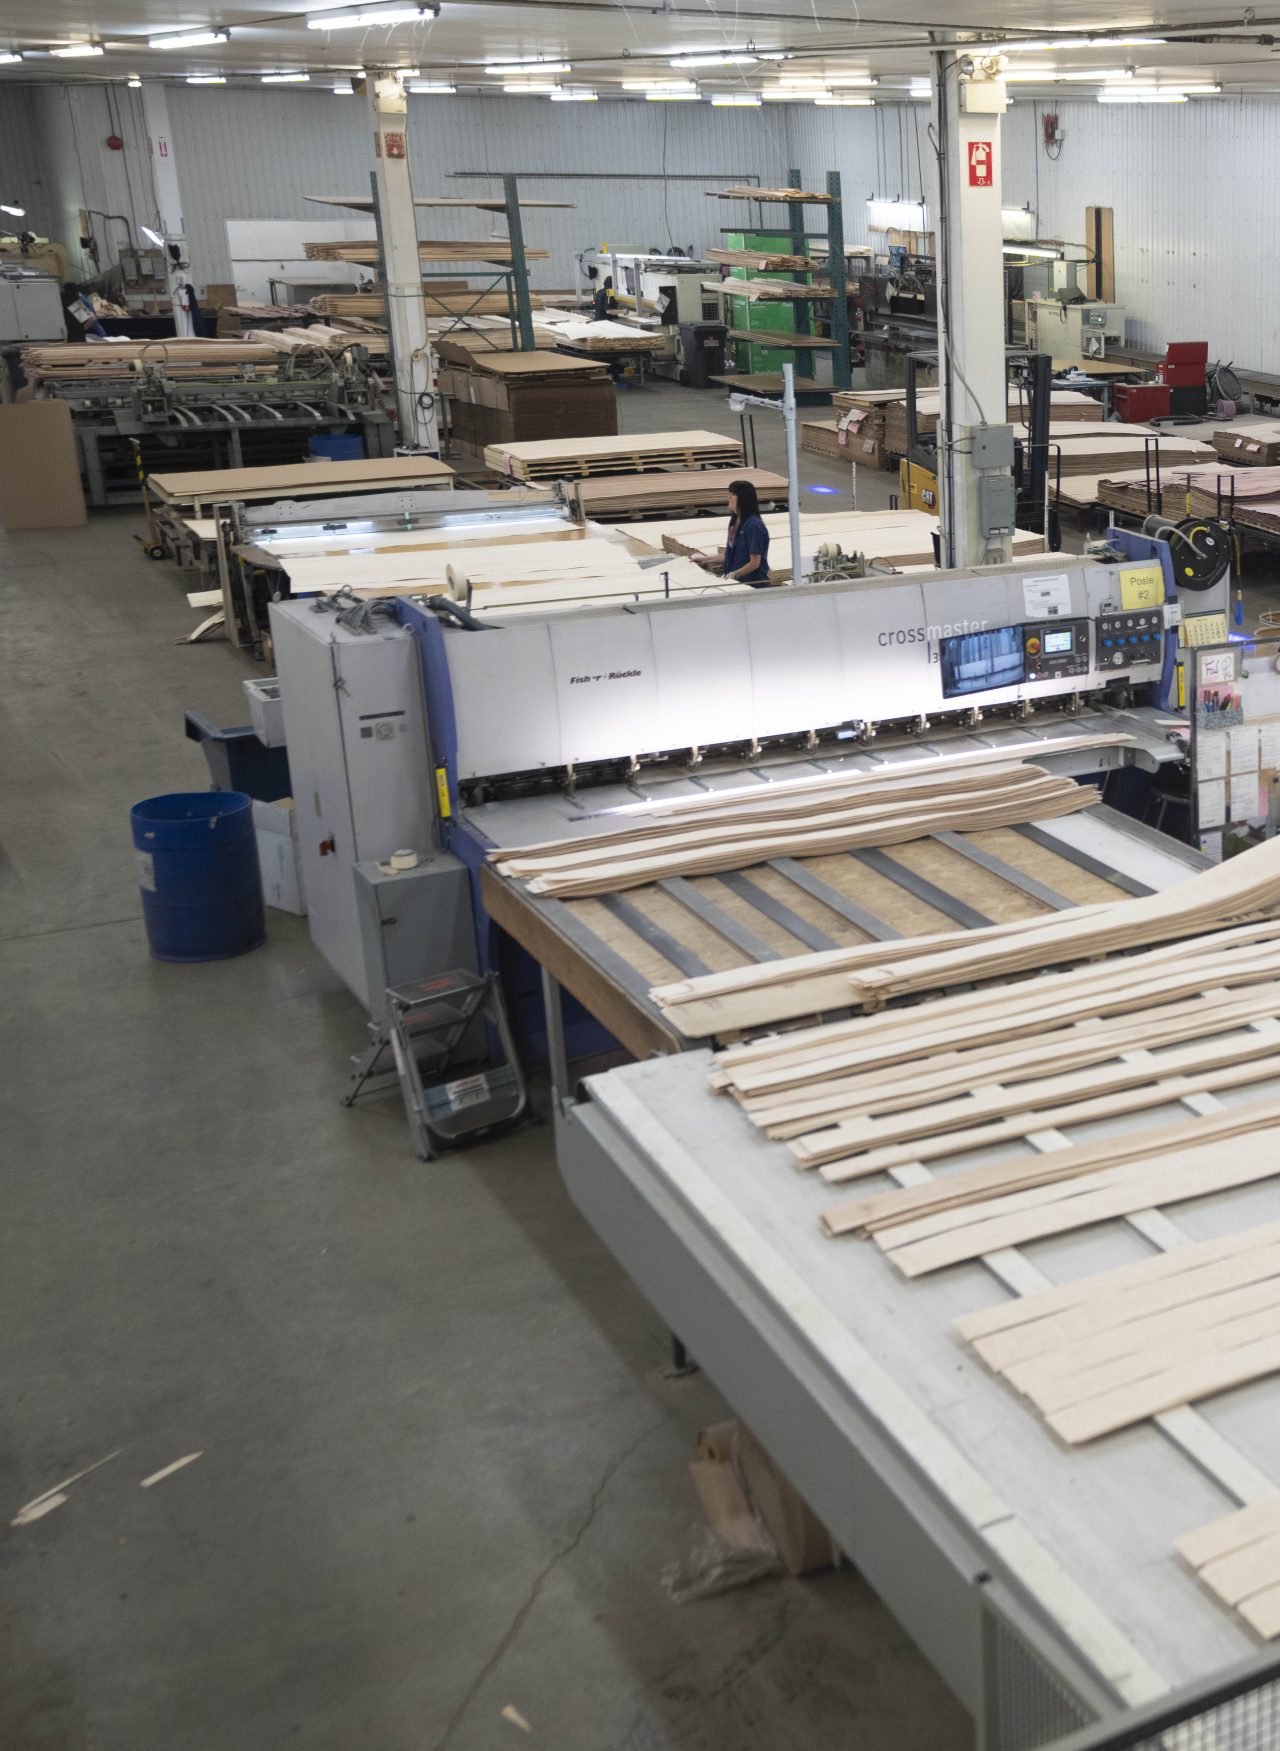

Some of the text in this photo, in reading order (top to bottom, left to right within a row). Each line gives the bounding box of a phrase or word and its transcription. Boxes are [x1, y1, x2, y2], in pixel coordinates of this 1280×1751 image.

[1130, 576, 1154, 586] Poste
[1137, 590, 1150, 600] #2
[878, 619, 988, 647] crossmaster
